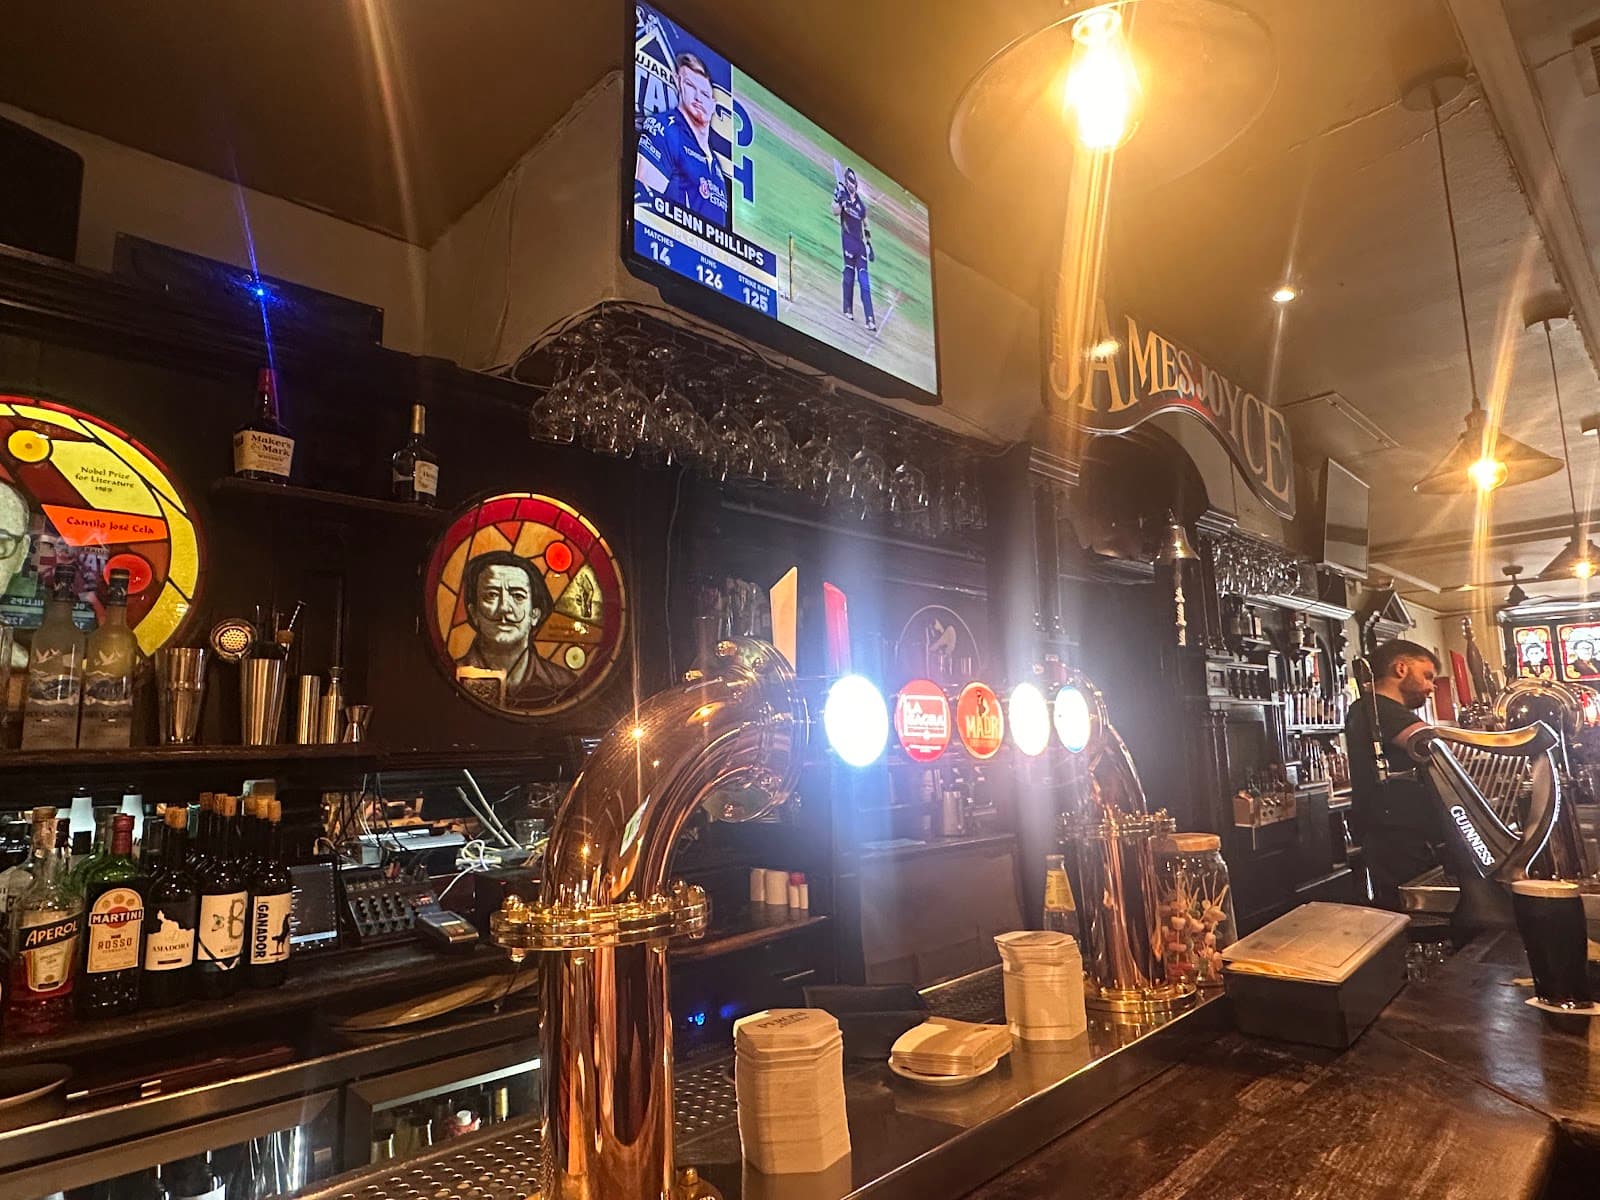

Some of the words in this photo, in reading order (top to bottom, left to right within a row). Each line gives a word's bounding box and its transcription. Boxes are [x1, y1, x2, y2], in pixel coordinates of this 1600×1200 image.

[643, 227, 674, 247] MATCHES
[654, 197, 703, 234] GLENN
[705, 223, 764, 266] PHILLIPS
[650, 242, 671, 266] 14
[700, 255, 717, 269] RUNS
[696, 265, 723, 290] 126
[742, 287, 768, 313] 125
[1050, 296, 1195, 412] JAMES
[1198, 362, 1290, 503] JOYCE
[261, 443, 290, 457] Mark
[75, 473, 88, 481] for
[91, 475, 135, 488] Literature
[81, 467, 106, 476] Nobel
[108, 470, 130, 480] Prize
[66, 516, 106, 529] Camilo
[109, 521, 129, 531] José
[132, 524, 154, 535] Cela
[1450, 804, 1496, 866] GUINNESS
[92, 908, 143, 924] MARTINI
[25, 920, 78, 947] APEROL
[256, 904, 270, 958] GANADOR
[97, 937, 133, 951] ROSSO
